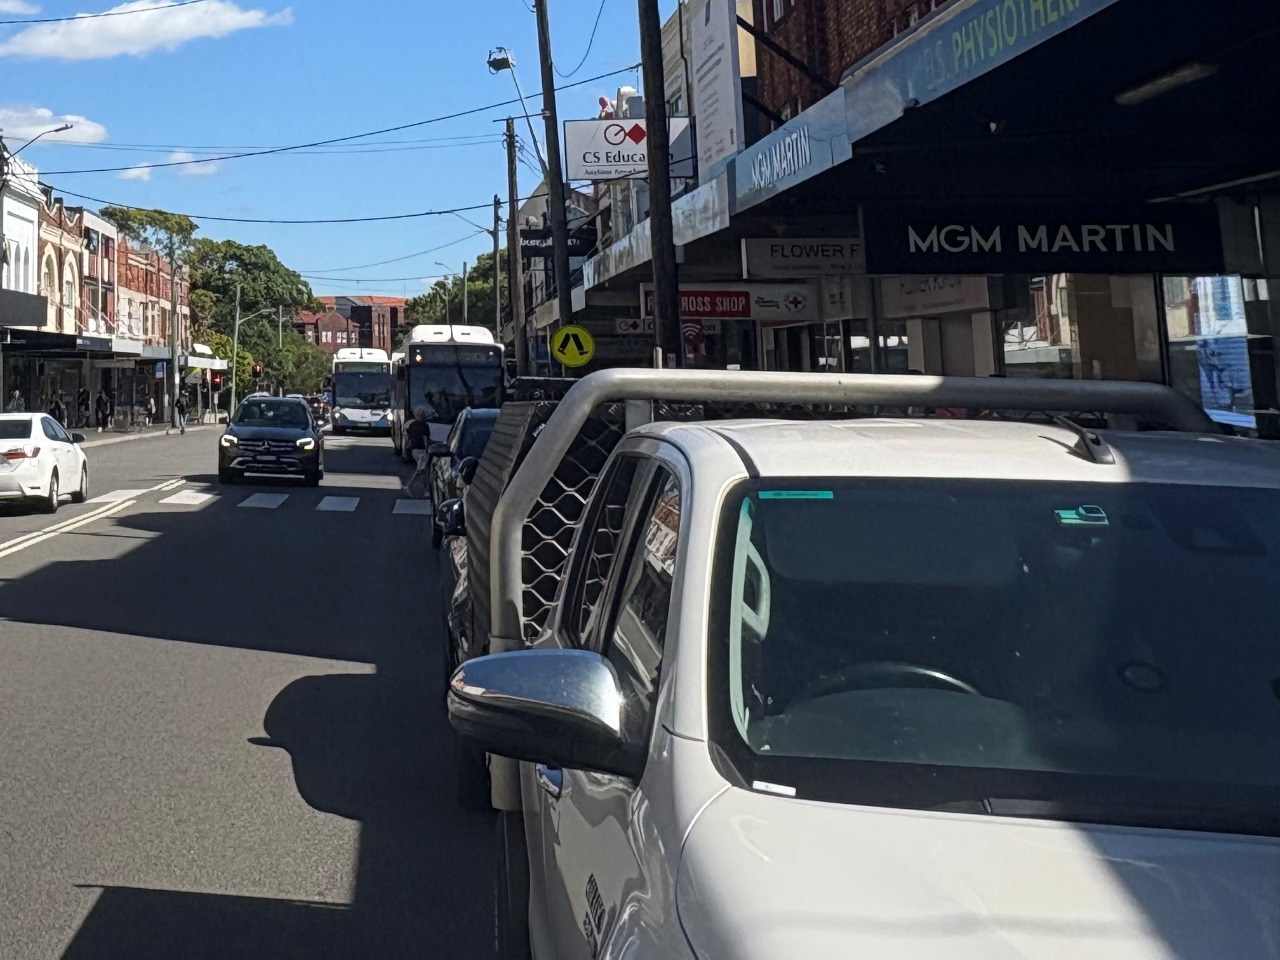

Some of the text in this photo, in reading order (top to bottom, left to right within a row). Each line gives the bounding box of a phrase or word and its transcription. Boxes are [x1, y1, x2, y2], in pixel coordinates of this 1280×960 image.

[583, 151, 601, 164] CS
[772, 125, 811, 183] MARTIN
[908, 223, 1175, 253] MGM MARTIN
[771, 244, 845, 258] FLOWER
[680, 296, 711, 312] ROSS
[715, 296, 746, 312] SHOP
